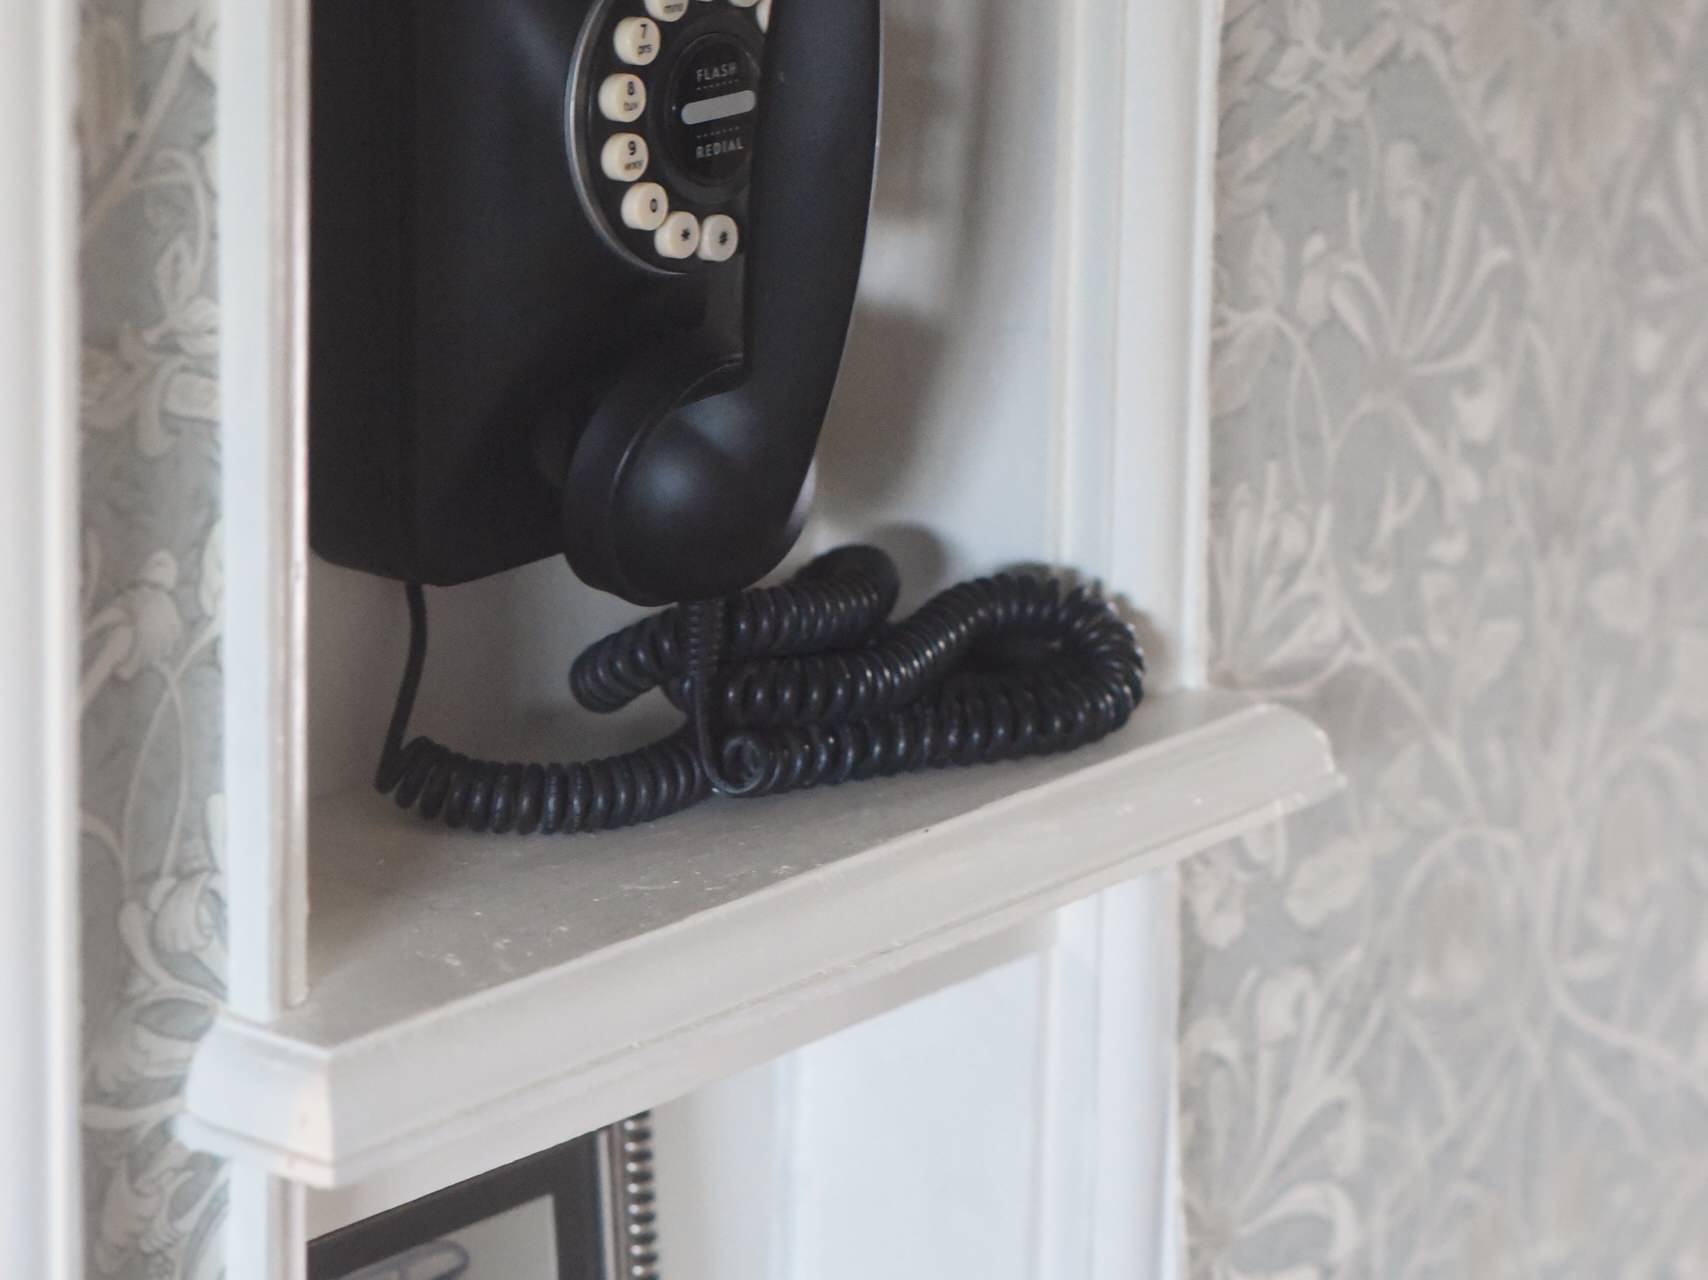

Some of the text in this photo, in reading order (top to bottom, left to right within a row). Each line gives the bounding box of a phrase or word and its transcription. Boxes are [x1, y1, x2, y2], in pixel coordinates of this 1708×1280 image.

[639, 23, 647, 40] 7
[696, 63, 737, 82] FLASH
[627, 81, 635, 96] 8
[628, 140, 636, 156] 9
[695, 136, 744, 159] REDIAL
